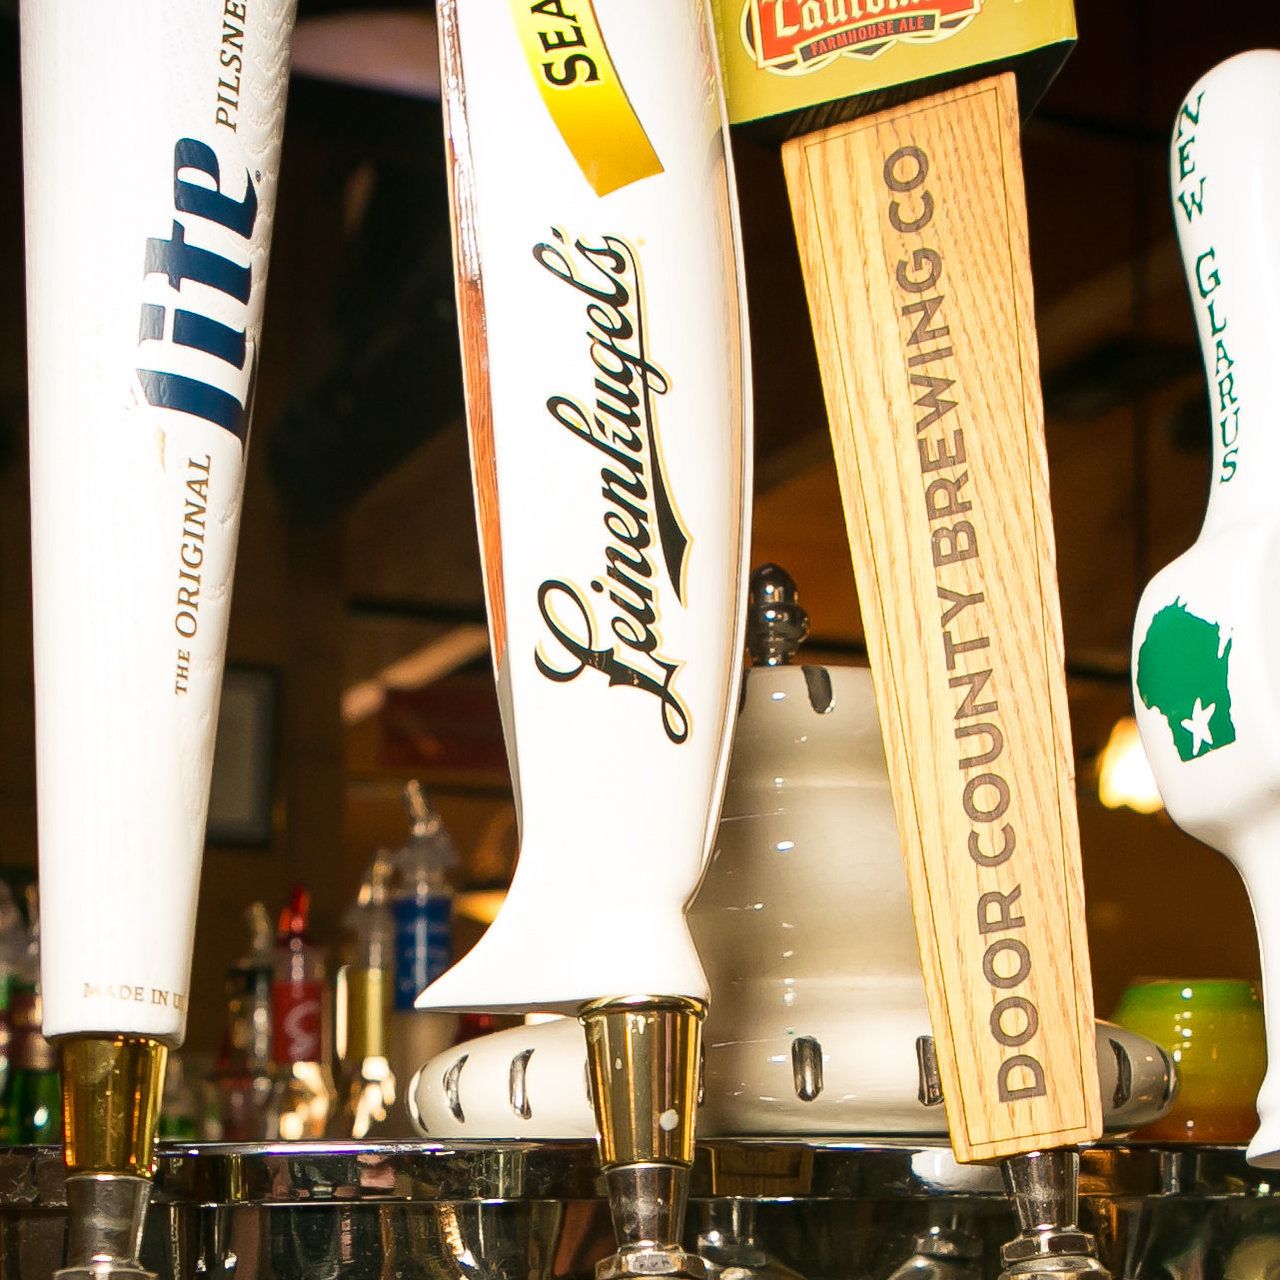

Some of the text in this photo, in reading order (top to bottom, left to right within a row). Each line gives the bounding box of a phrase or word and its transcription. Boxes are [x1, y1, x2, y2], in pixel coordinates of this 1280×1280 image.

[215, 0, 248, 134] PILSNE
[810, 15, 926, 57] FARMHOUSE ALE
[1176, 91, 1241, 484] NEW GLARUS
[175, 454, 211, 696] THE ORIGINAL
[532, 226, 693, 746] Leinenkugel's
[883, 144, 1047, 1104] DOOR COUNTY BREWING CO
[152, 988, 169, 1006] IN
